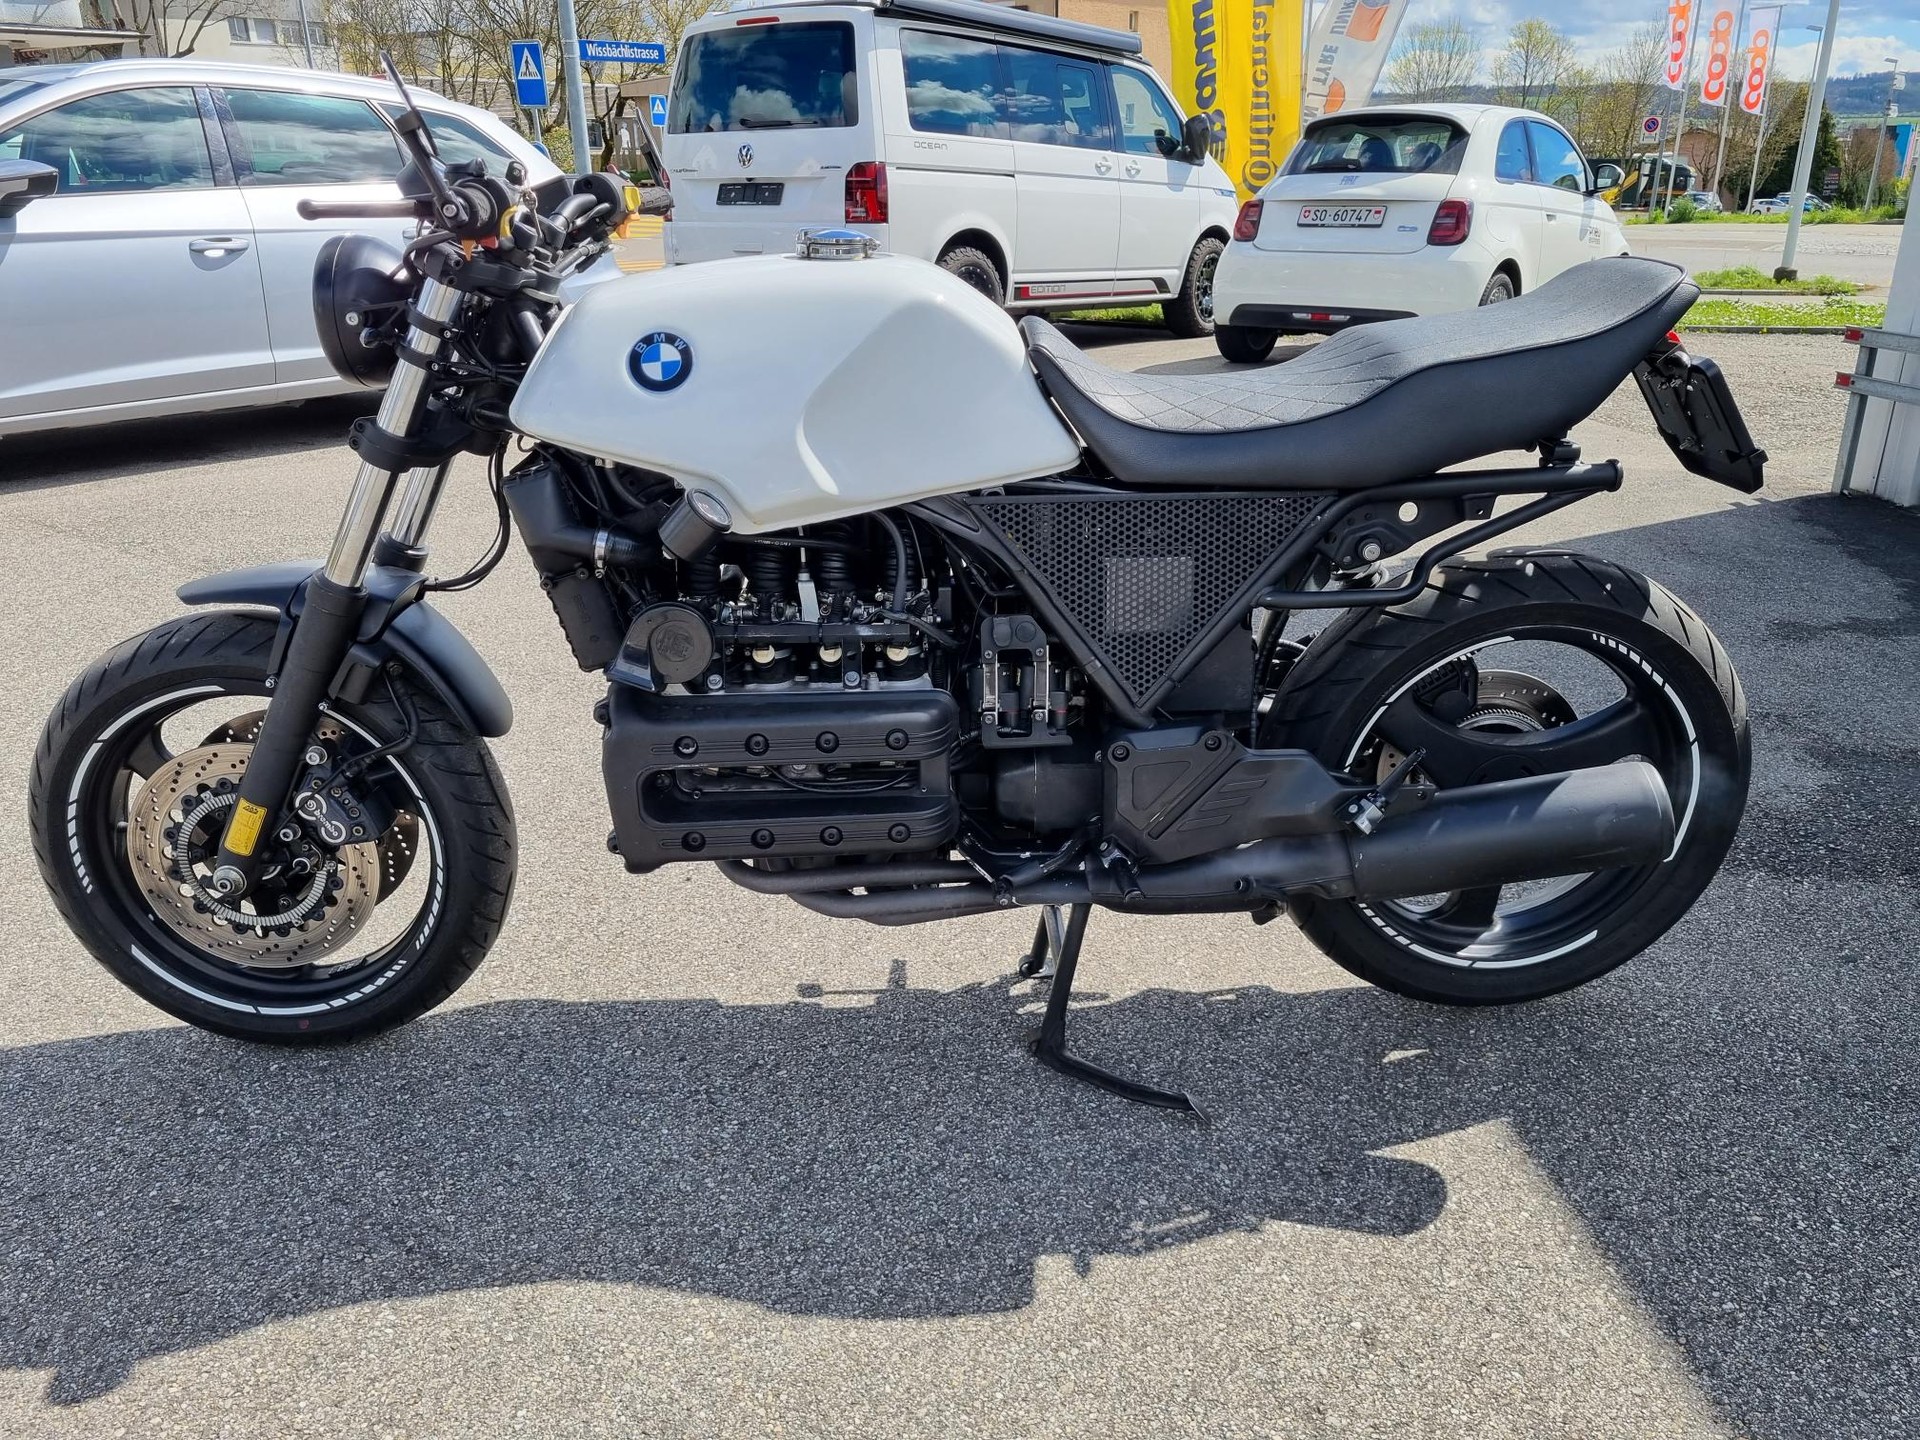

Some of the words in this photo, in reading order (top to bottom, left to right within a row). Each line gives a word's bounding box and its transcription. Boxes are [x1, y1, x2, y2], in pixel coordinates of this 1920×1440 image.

[585, 43, 659, 60] Wissbächlistrasse
[913, 141, 948, 150] OCEAN
[1031, 284, 1066, 294] EDITION
[634, 333, 687, 353] BMW
[314, 810, 339, 837] brembo
